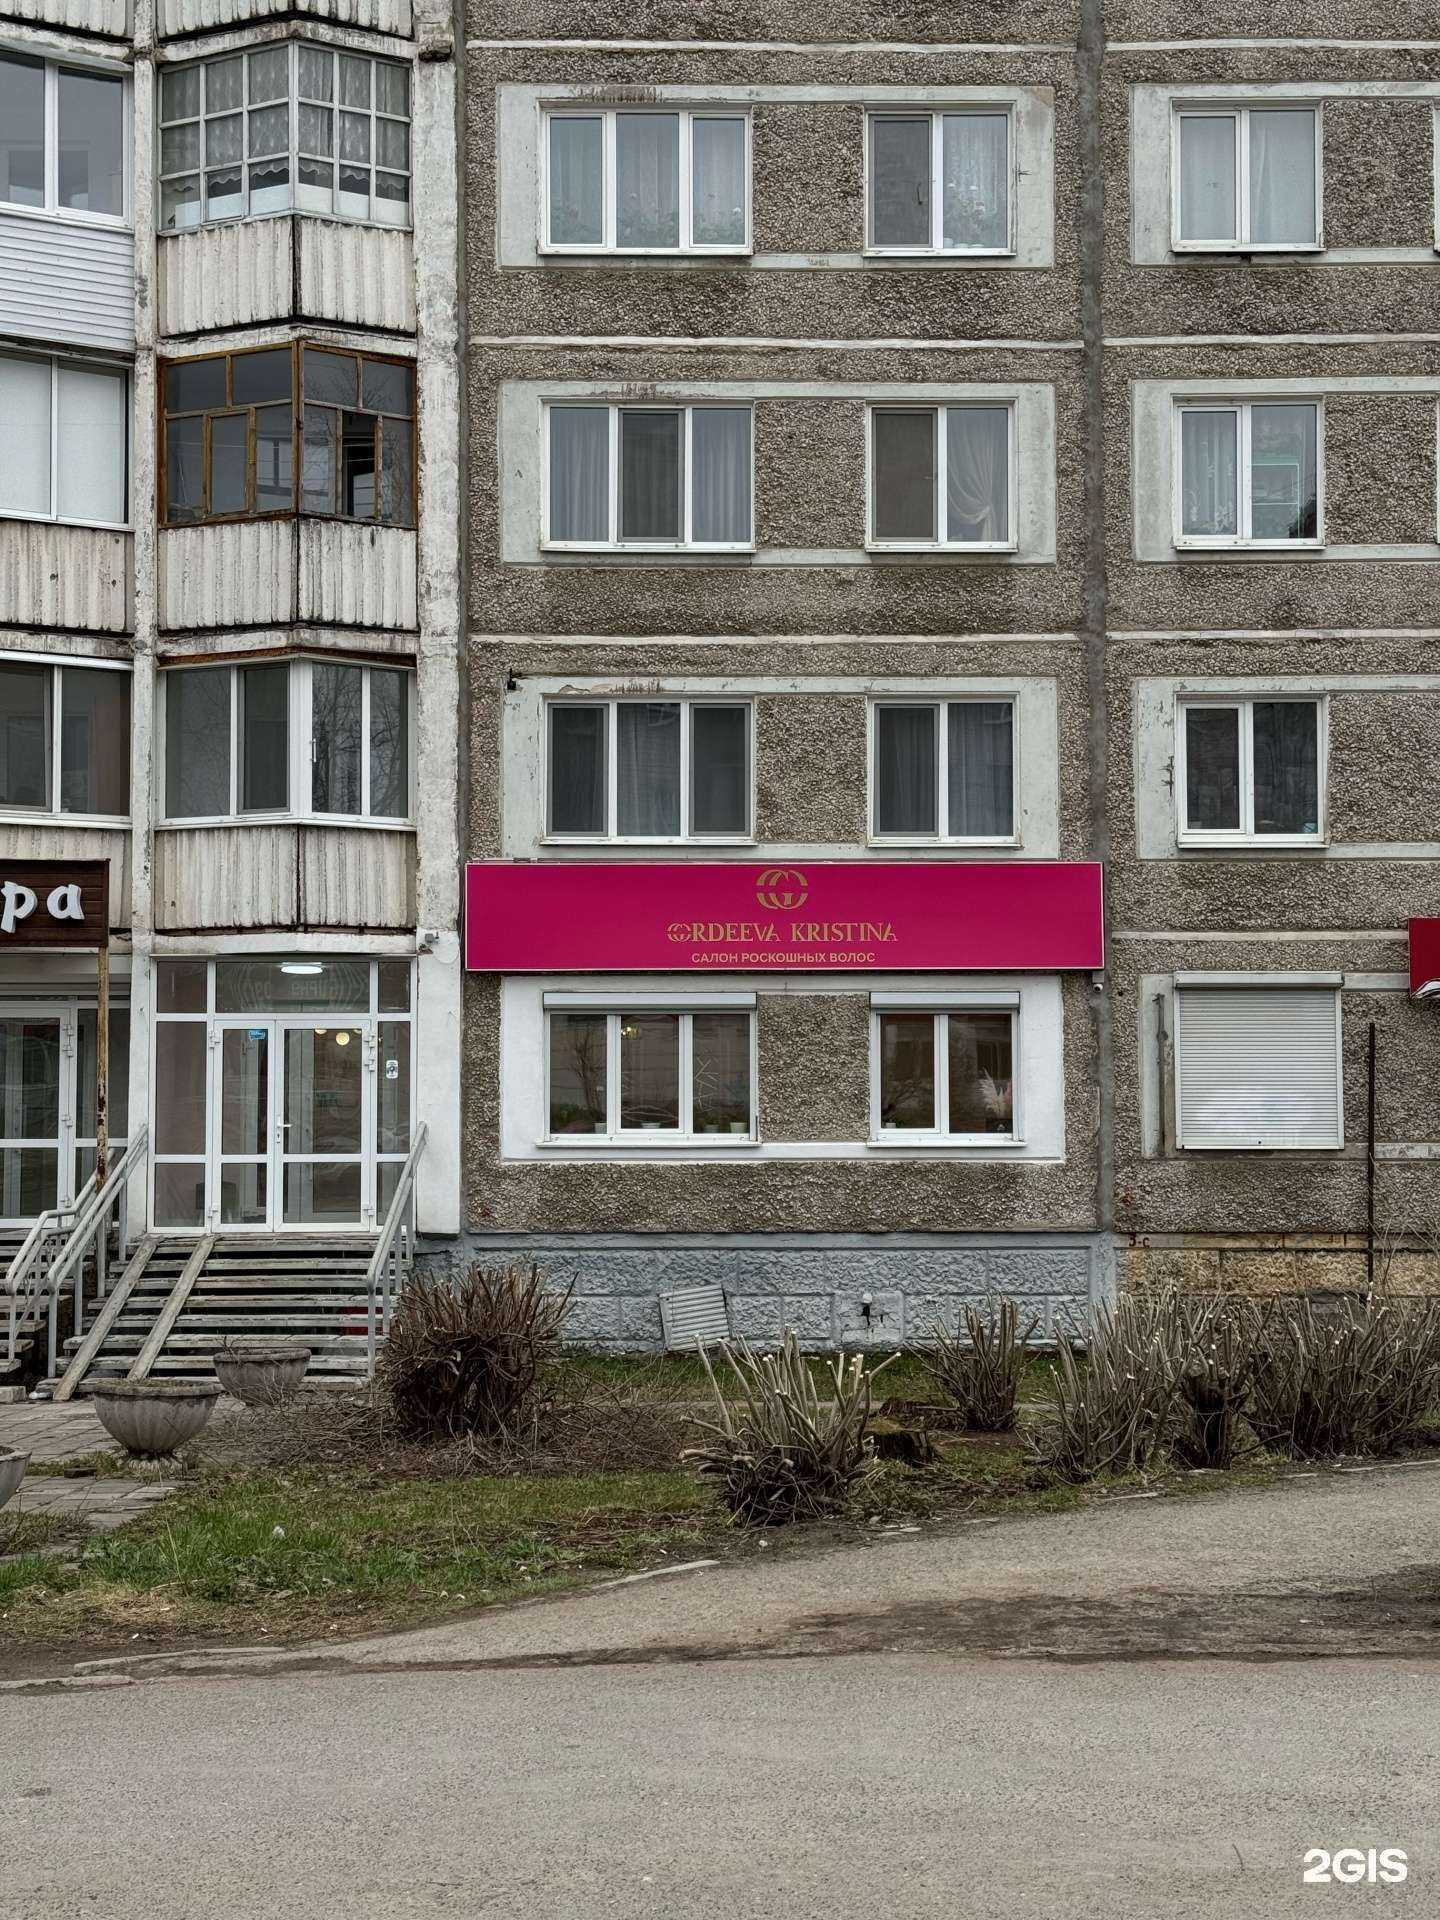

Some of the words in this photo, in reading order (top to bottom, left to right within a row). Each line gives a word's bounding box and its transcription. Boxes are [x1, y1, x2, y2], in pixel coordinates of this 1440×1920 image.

[790, 922, 899, 942] KRISTINA
[691, 952, 738, 963] САЛОН
[741, 952, 826, 963] РОСКОШНЫХ
[829, 952, 876, 963] ВОЛОС
